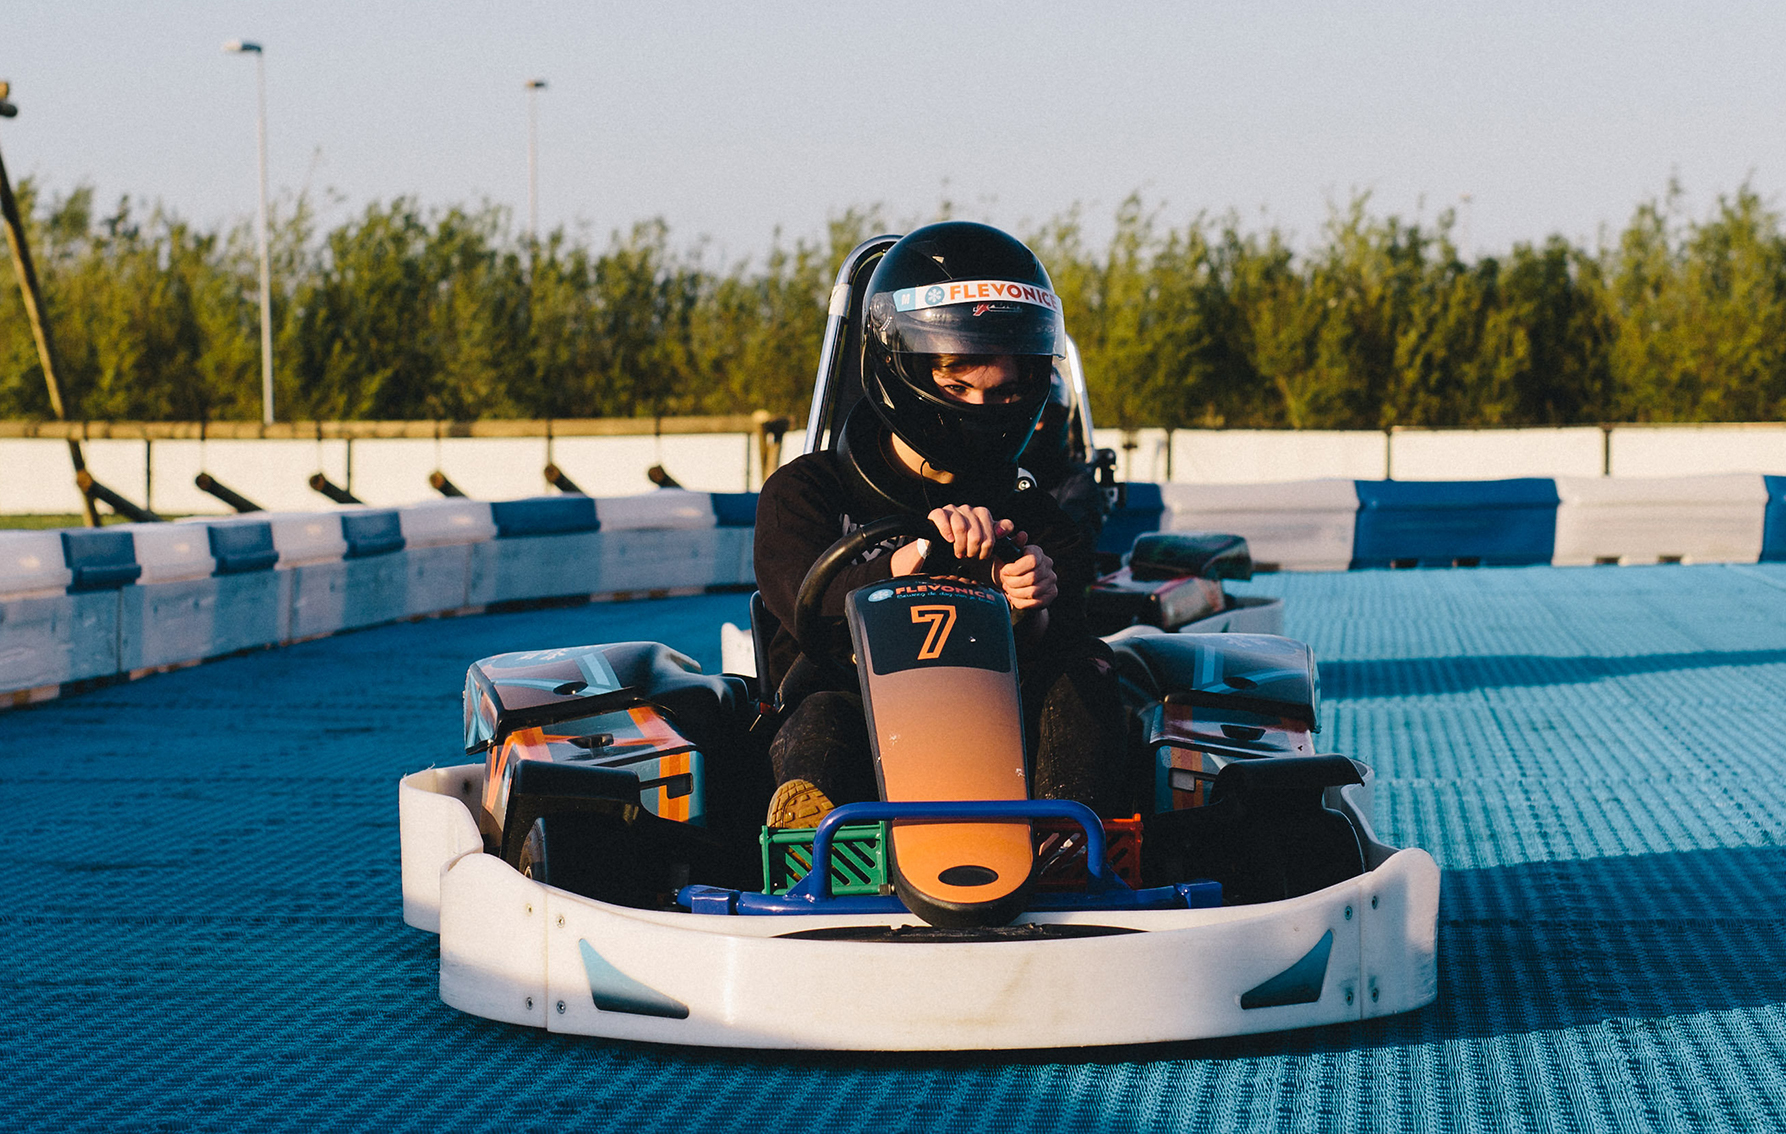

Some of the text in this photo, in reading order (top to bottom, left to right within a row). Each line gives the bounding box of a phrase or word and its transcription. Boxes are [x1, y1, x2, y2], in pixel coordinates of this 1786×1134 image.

[950, 283, 1057, 309] FLEVONICE
[895, 585, 995, 601] FLEVONICE
[910, 604, 957, 661] 7
